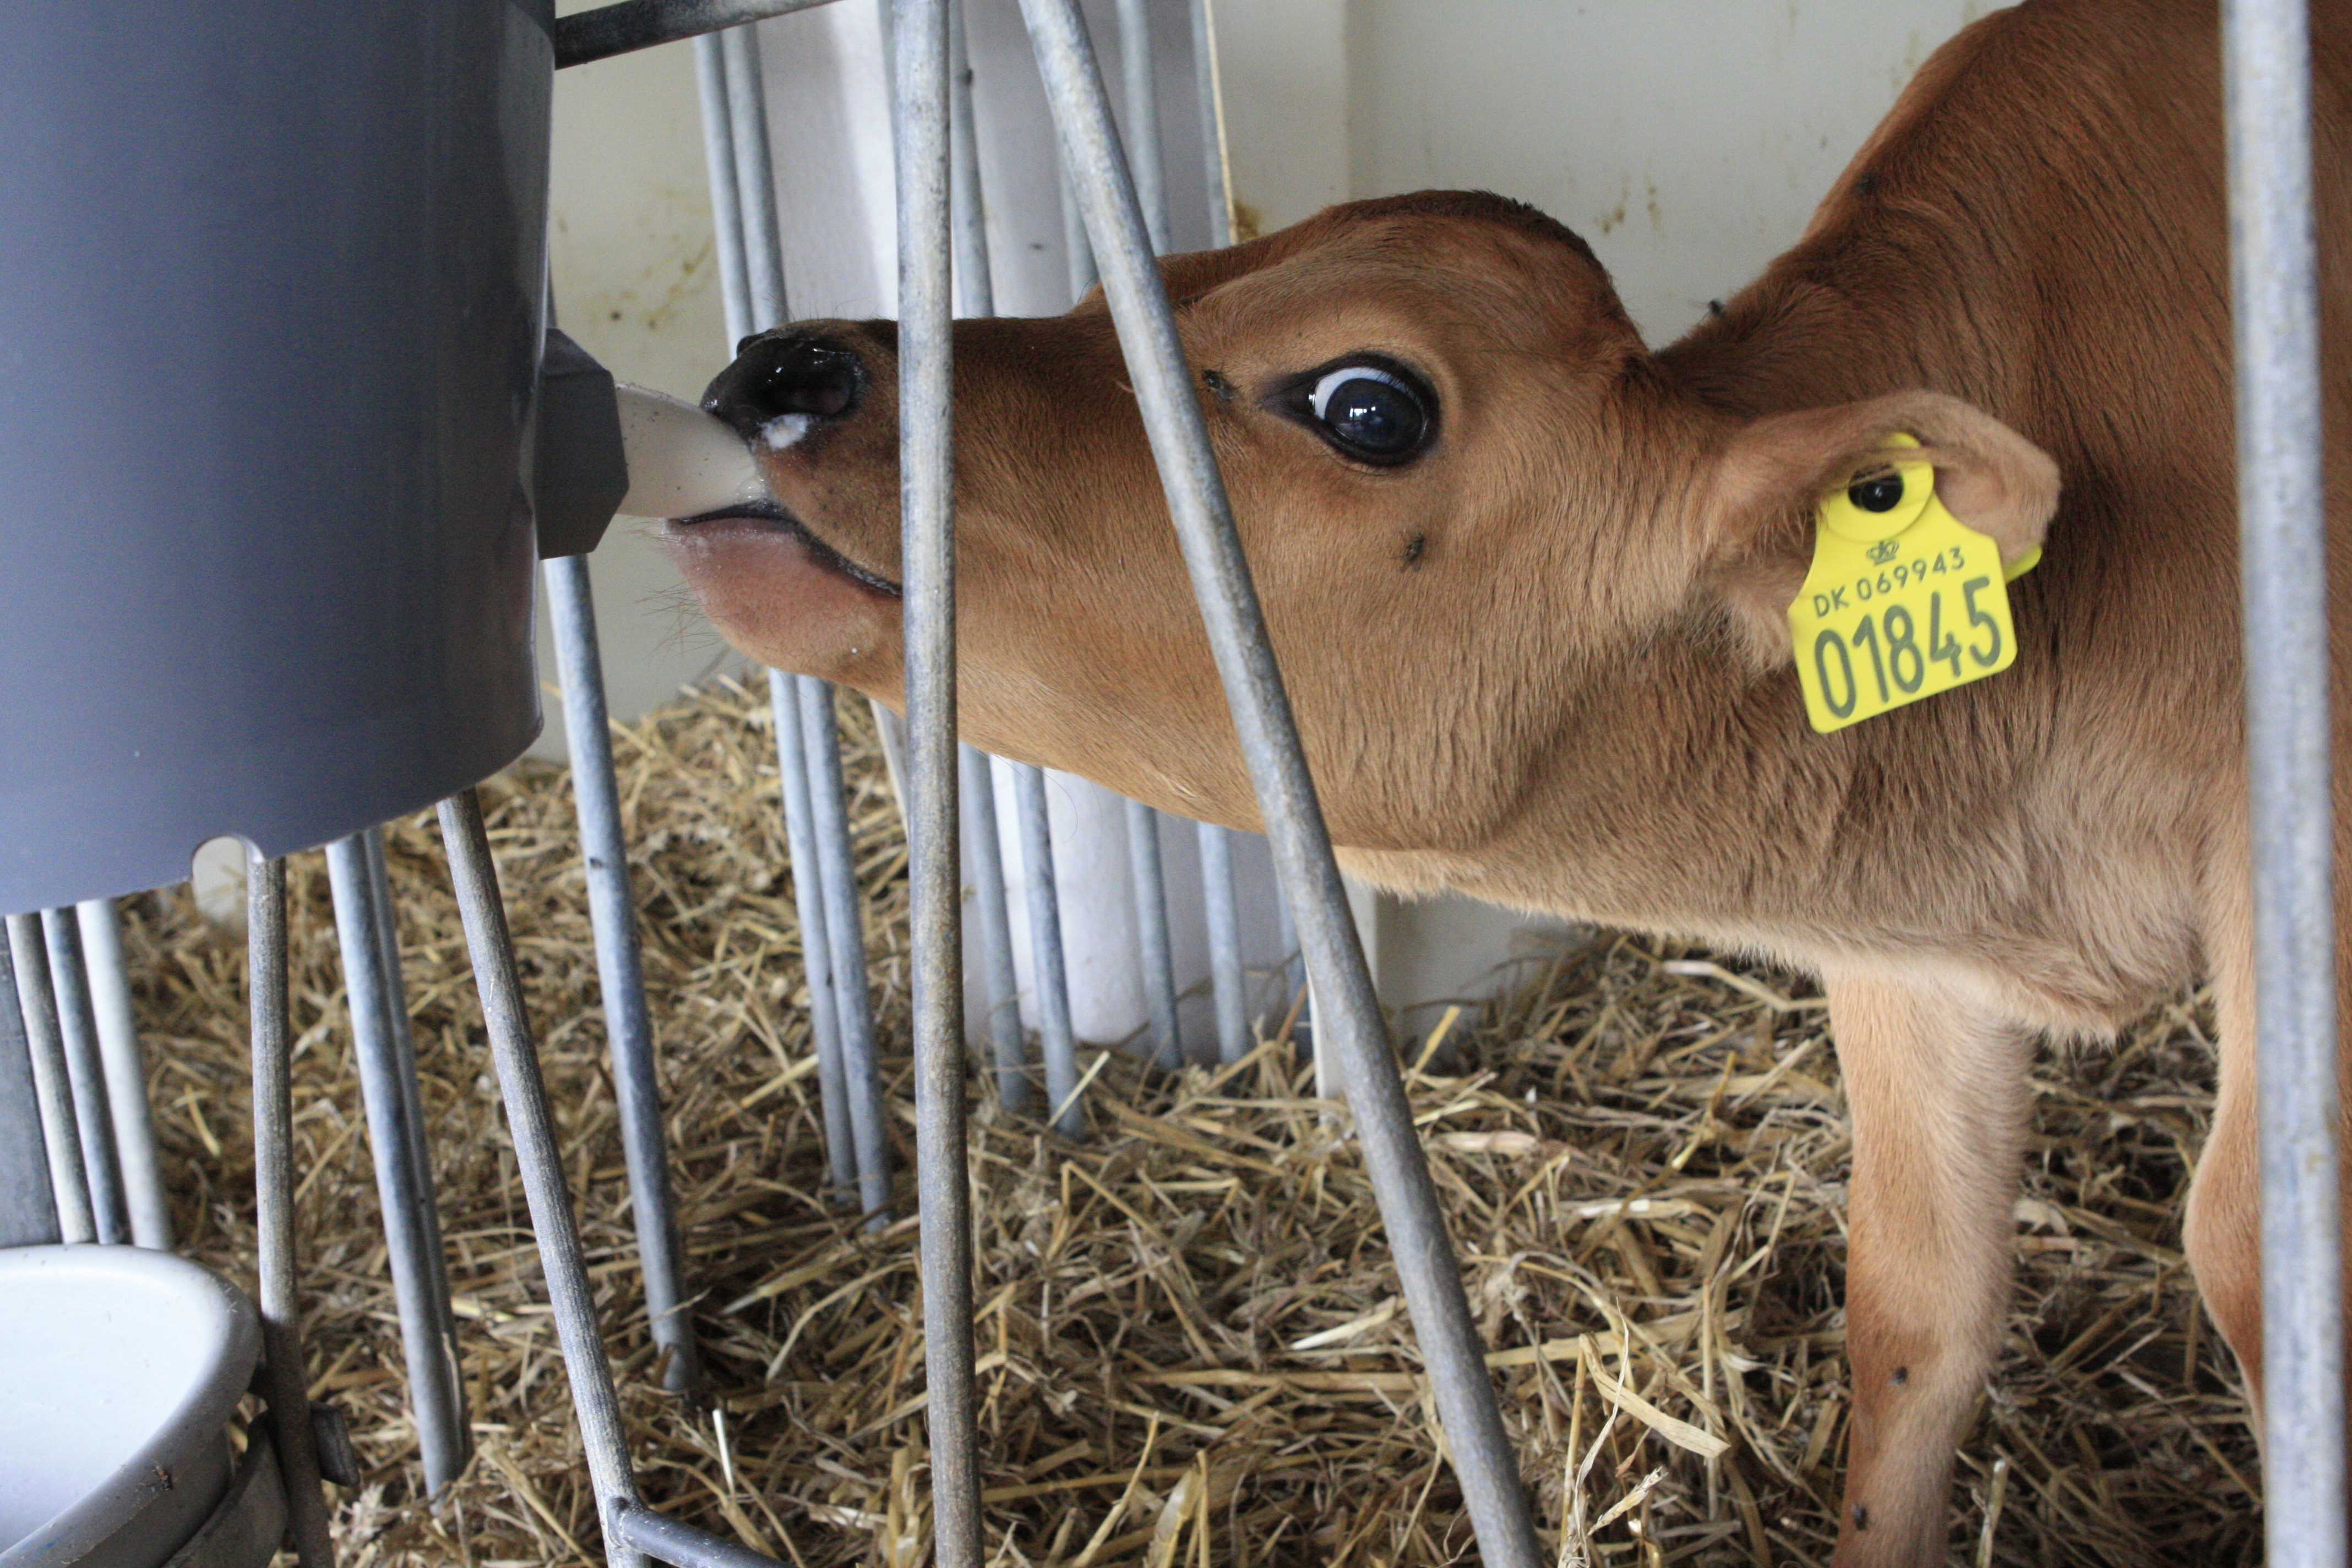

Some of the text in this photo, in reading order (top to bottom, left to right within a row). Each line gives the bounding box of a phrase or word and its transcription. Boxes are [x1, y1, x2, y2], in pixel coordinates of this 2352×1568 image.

[1813, 546, 1966, 618] DK 069943
[1814, 575, 2001, 719] 01845
